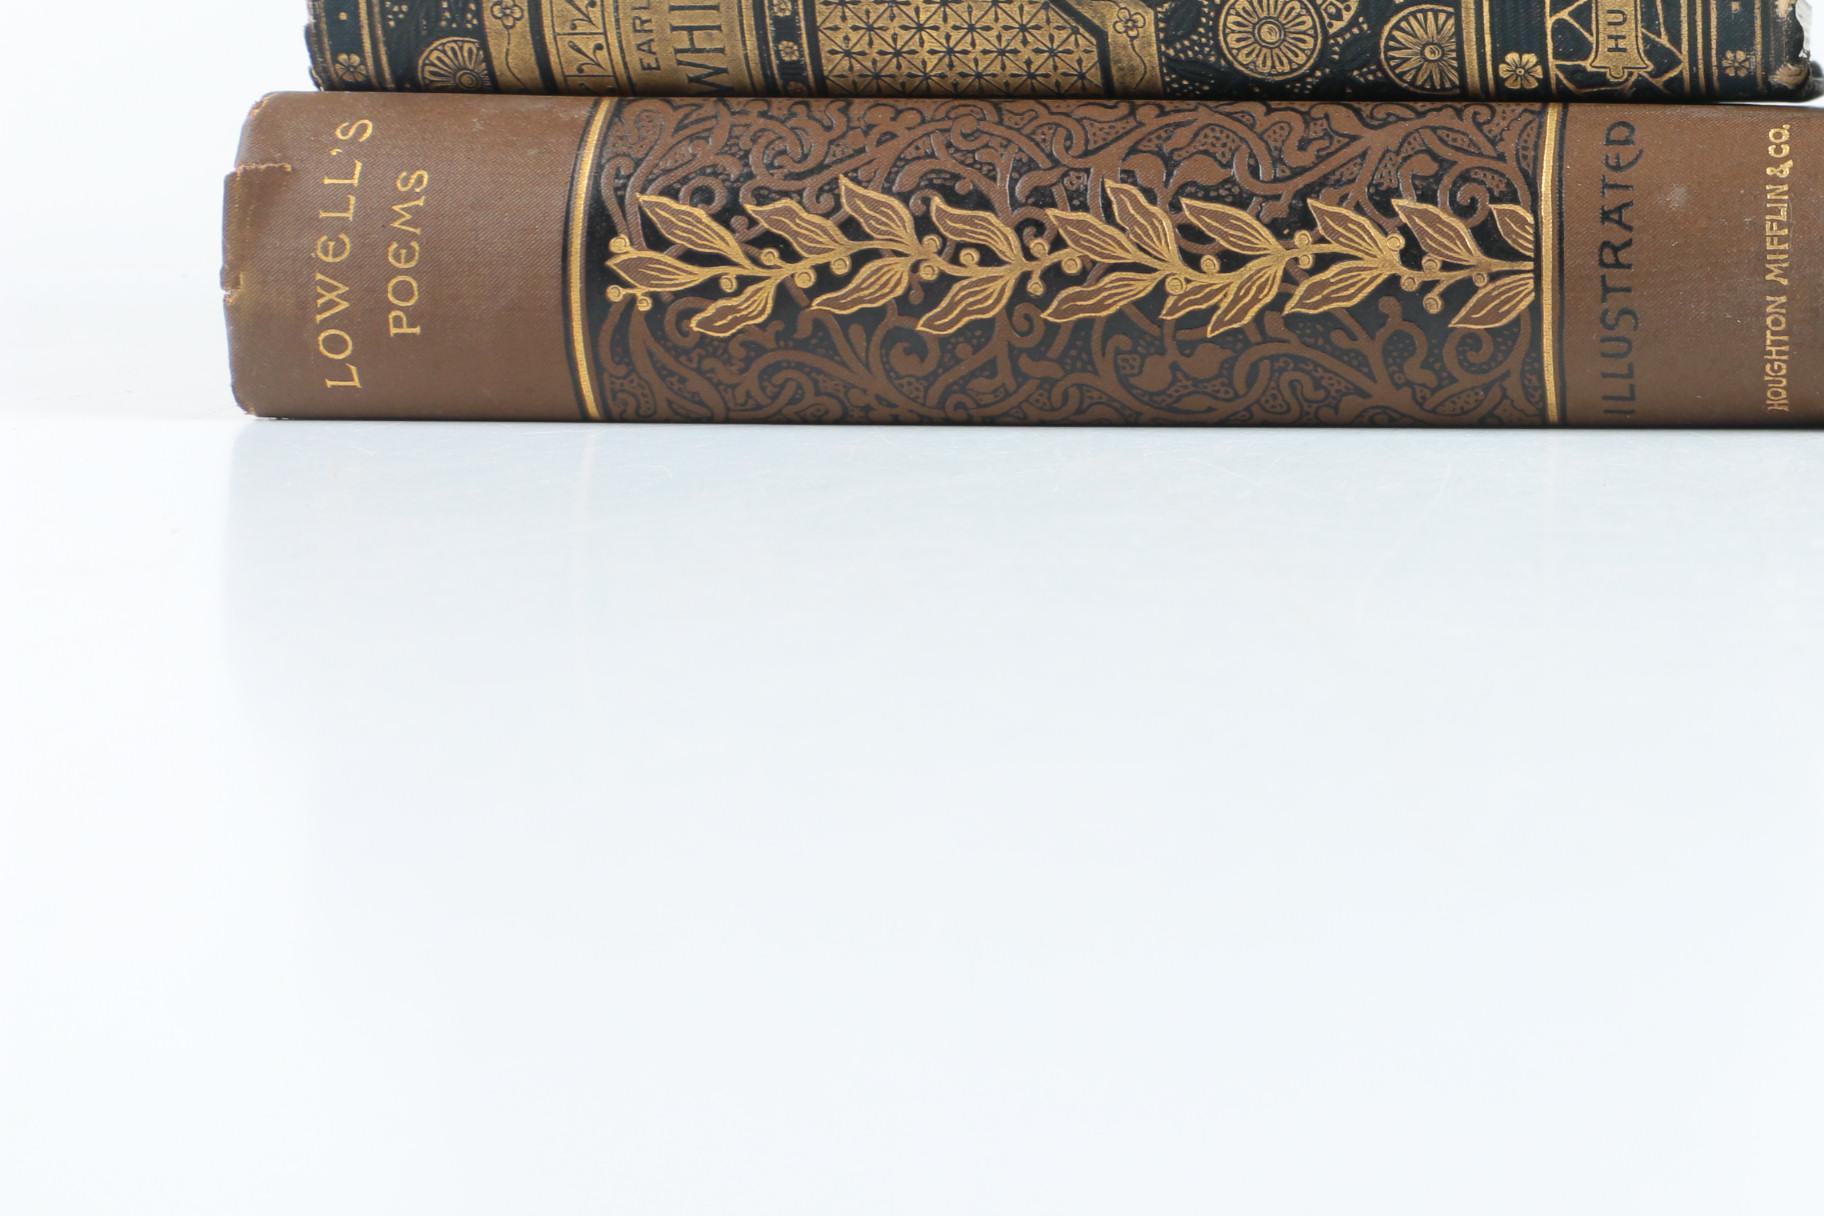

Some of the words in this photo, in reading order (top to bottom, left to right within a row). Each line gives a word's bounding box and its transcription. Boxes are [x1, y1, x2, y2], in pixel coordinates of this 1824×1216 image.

[316, 119, 373, 389] LOWELL'S
[387, 169, 428, 337] POEMS
[1601, 120, 1645, 418] ILLUSTRATED
[1767, 184, 1791, 285] MIFFLIN
[1767, 295, 1791, 412] HOUGHTON
